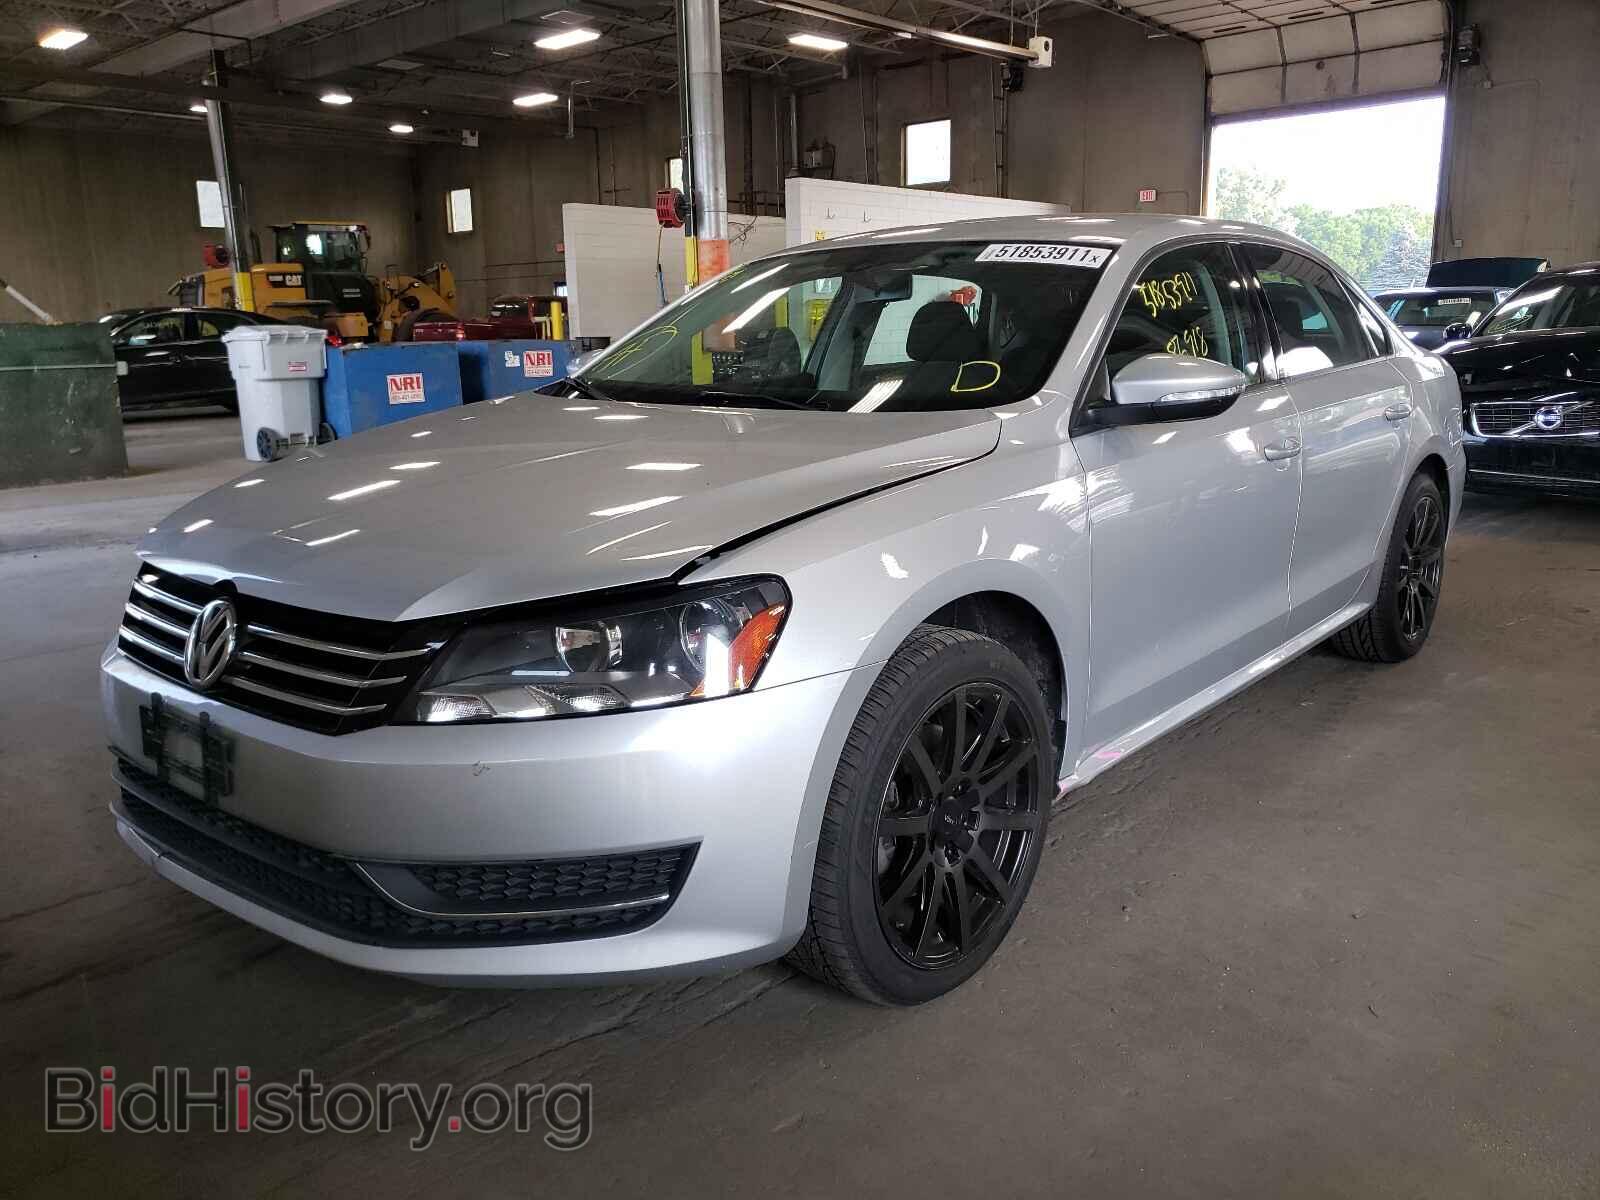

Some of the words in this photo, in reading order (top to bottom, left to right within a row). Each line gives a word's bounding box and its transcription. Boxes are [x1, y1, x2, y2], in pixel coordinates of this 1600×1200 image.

[994, 244, 1090, 262] 51853911
[285, 274, 303, 286] CAT
[525, 351, 551, 366] NRI
[389, 375, 422, 391] NRI
